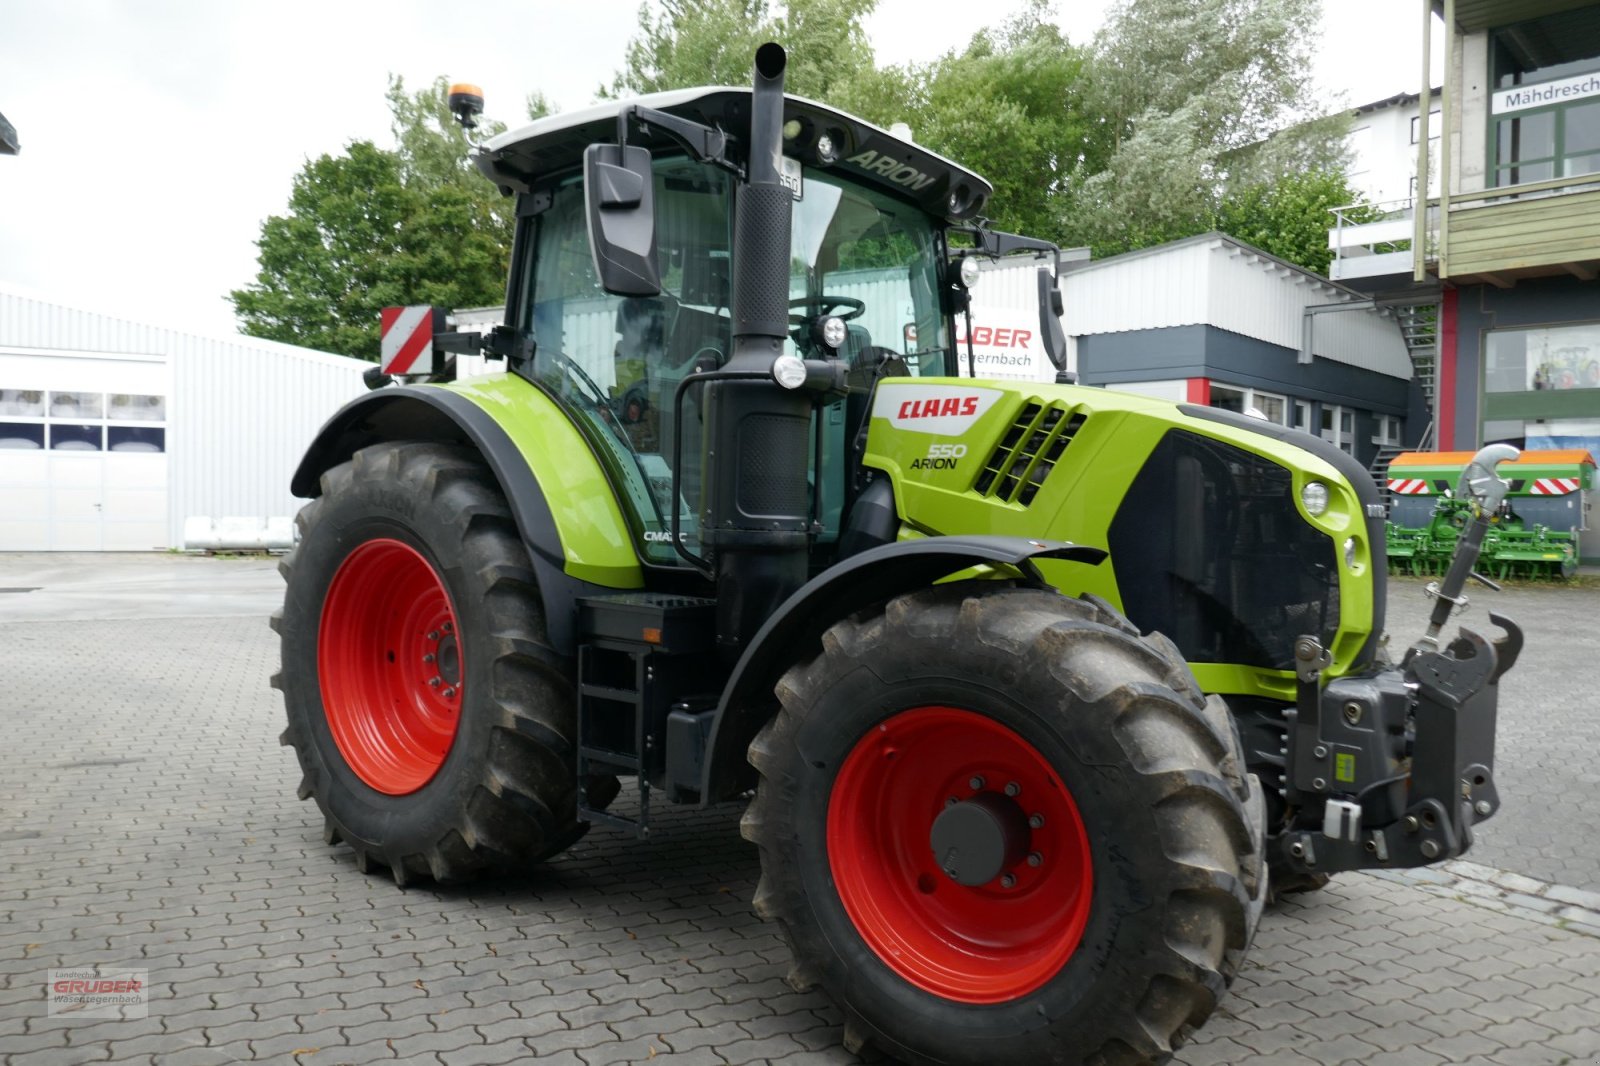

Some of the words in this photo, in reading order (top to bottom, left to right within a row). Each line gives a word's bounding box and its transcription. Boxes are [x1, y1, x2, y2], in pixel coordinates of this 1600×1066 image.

[1505, 77, 1600, 107] Mähdresch
[846, 150, 936, 191] ARION
[898, 396, 979, 419] CLAAS
[927, 444, 967, 458] 550
[910, 458, 957, 469] ARION
[643, 531, 688, 542] CMAC
